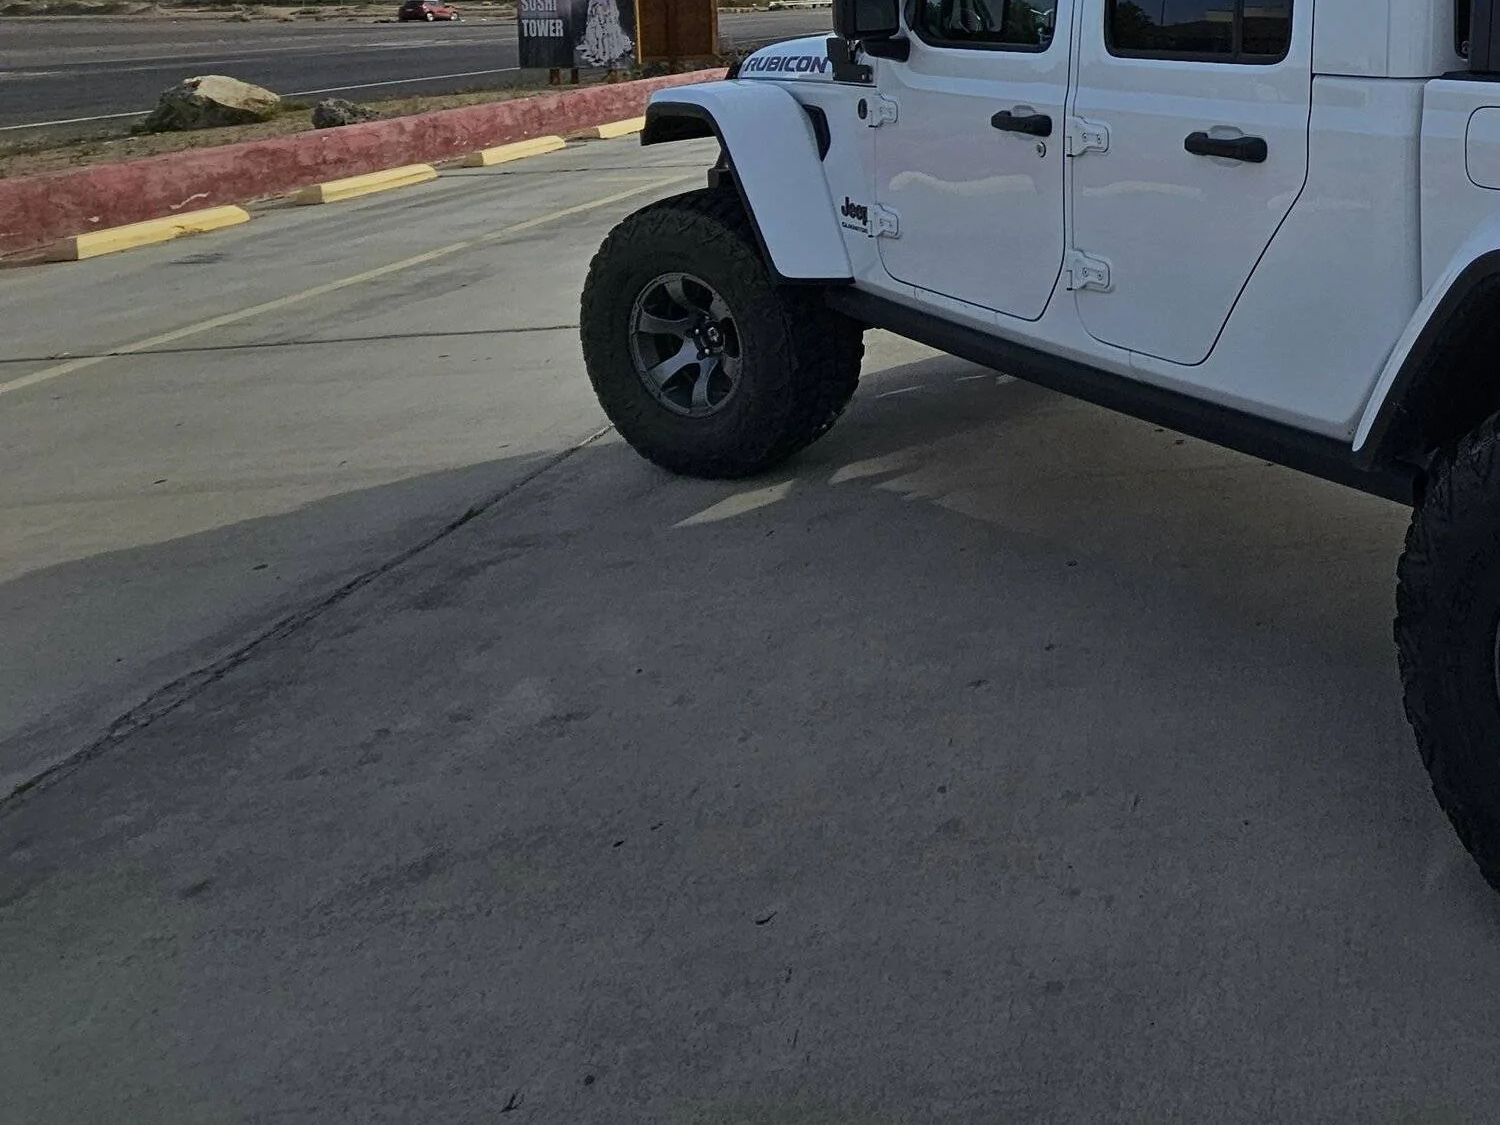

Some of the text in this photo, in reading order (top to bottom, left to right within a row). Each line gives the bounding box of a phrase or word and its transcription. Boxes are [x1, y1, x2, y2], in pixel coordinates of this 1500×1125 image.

[521, 18, 564, 37] TOWER
[744, 54, 830, 74] RUBICON
[841, 196, 868, 226] Jeep
